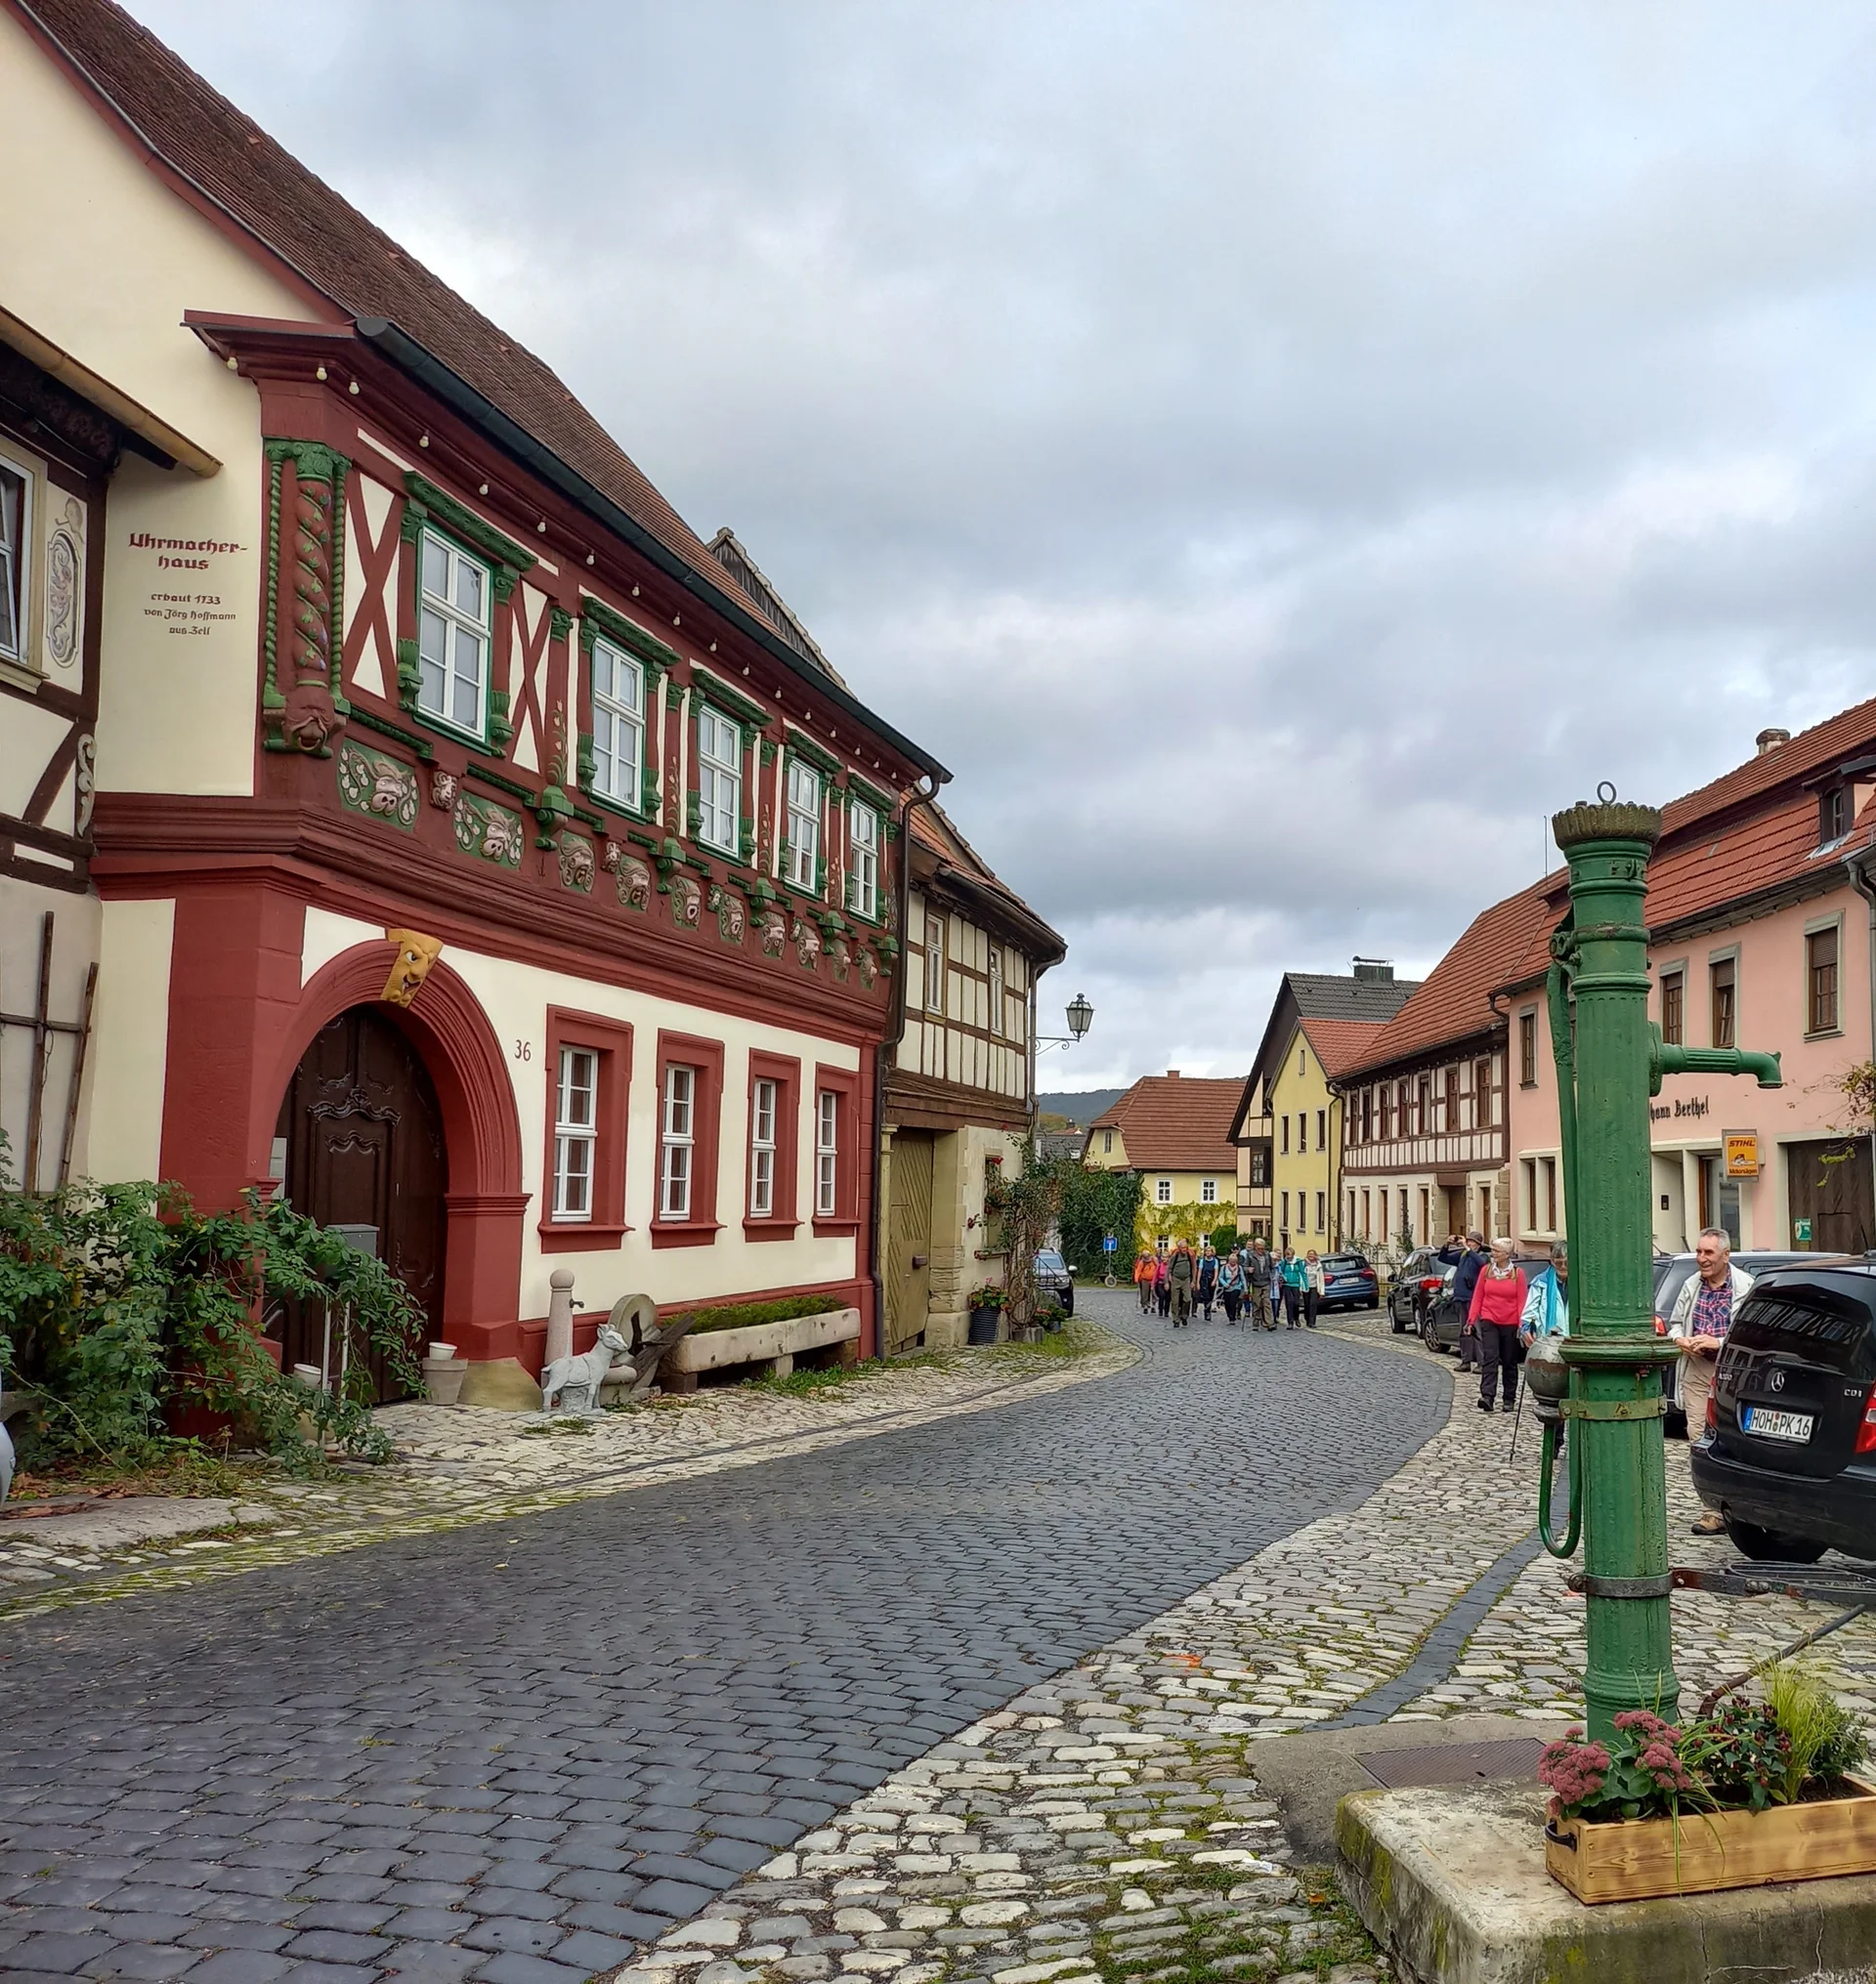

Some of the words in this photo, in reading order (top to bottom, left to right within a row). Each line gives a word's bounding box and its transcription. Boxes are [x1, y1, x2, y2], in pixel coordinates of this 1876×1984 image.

[128, 532, 248, 555] Uhrmacher-
[158, 555, 210, 570] haus
[150, 593, 192, 603] erbaut
[194, 594, 221, 605] 1733
[164, 609, 188, 620] Jörg
[191, 611, 236, 621] Hoffmann
[189, 625, 211, 635] Zell
[514, 1038, 532, 1062] 36
[1649, 1102, 1671, 1124] hann
[1674, 1095, 1710, 1119] Berthel
[1844, 1388, 1862, 1398] CDI
[1752, 1410, 1774, 1431] HOH
[1778, 1414, 1795, 1434] PK
[1795, 1416, 1811, 1436] 16
